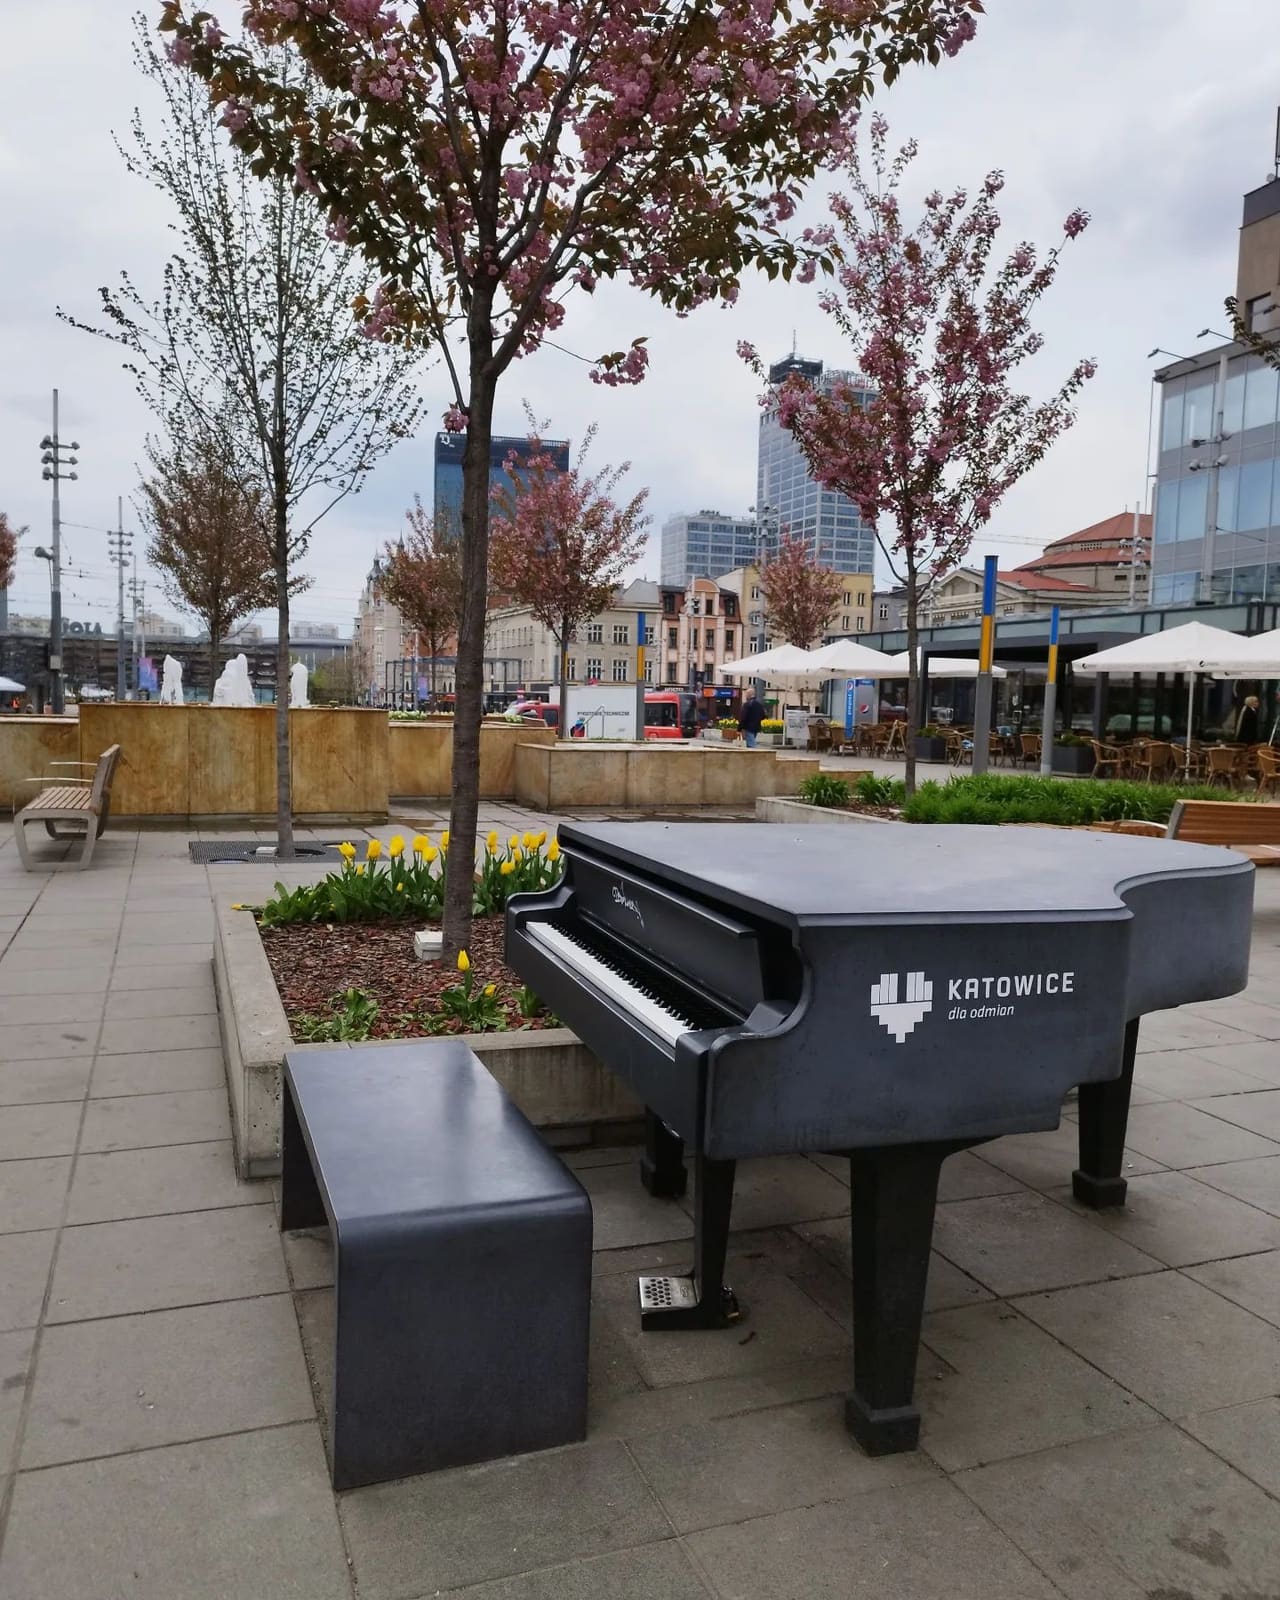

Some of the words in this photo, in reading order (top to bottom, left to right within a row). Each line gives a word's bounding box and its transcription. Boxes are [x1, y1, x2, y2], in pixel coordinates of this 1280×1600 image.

[948, 972, 1075, 1001] KATOWICE
[948, 1007, 966, 1020] dla
[970, 1004, 1015, 1019] odmian
